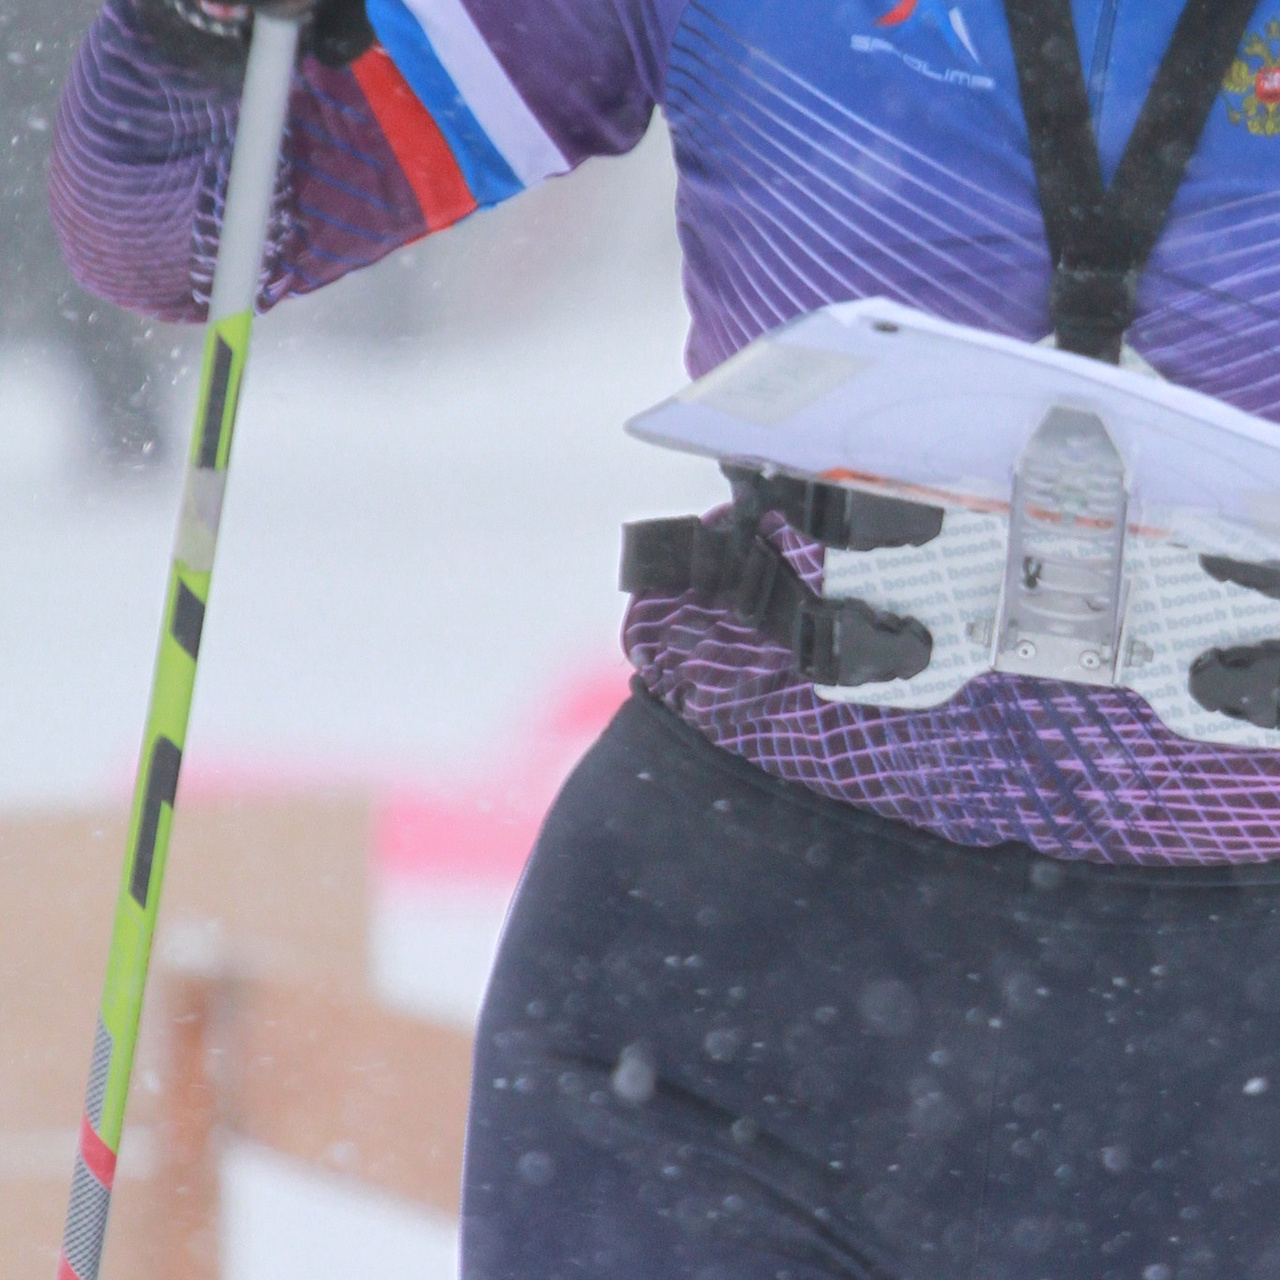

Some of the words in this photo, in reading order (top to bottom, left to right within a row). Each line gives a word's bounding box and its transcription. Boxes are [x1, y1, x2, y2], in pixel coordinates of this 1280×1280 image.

[941, 538, 1001, 558] booch
[875, 549, 936, 570] booch
[1149, 552, 1197, 568] booc
[881, 569, 943, 591] booch
[952, 583, 1002, 601] booc
[1160, 587, 1221, 609] booch
[1165, 608, 1227, 630] booch
